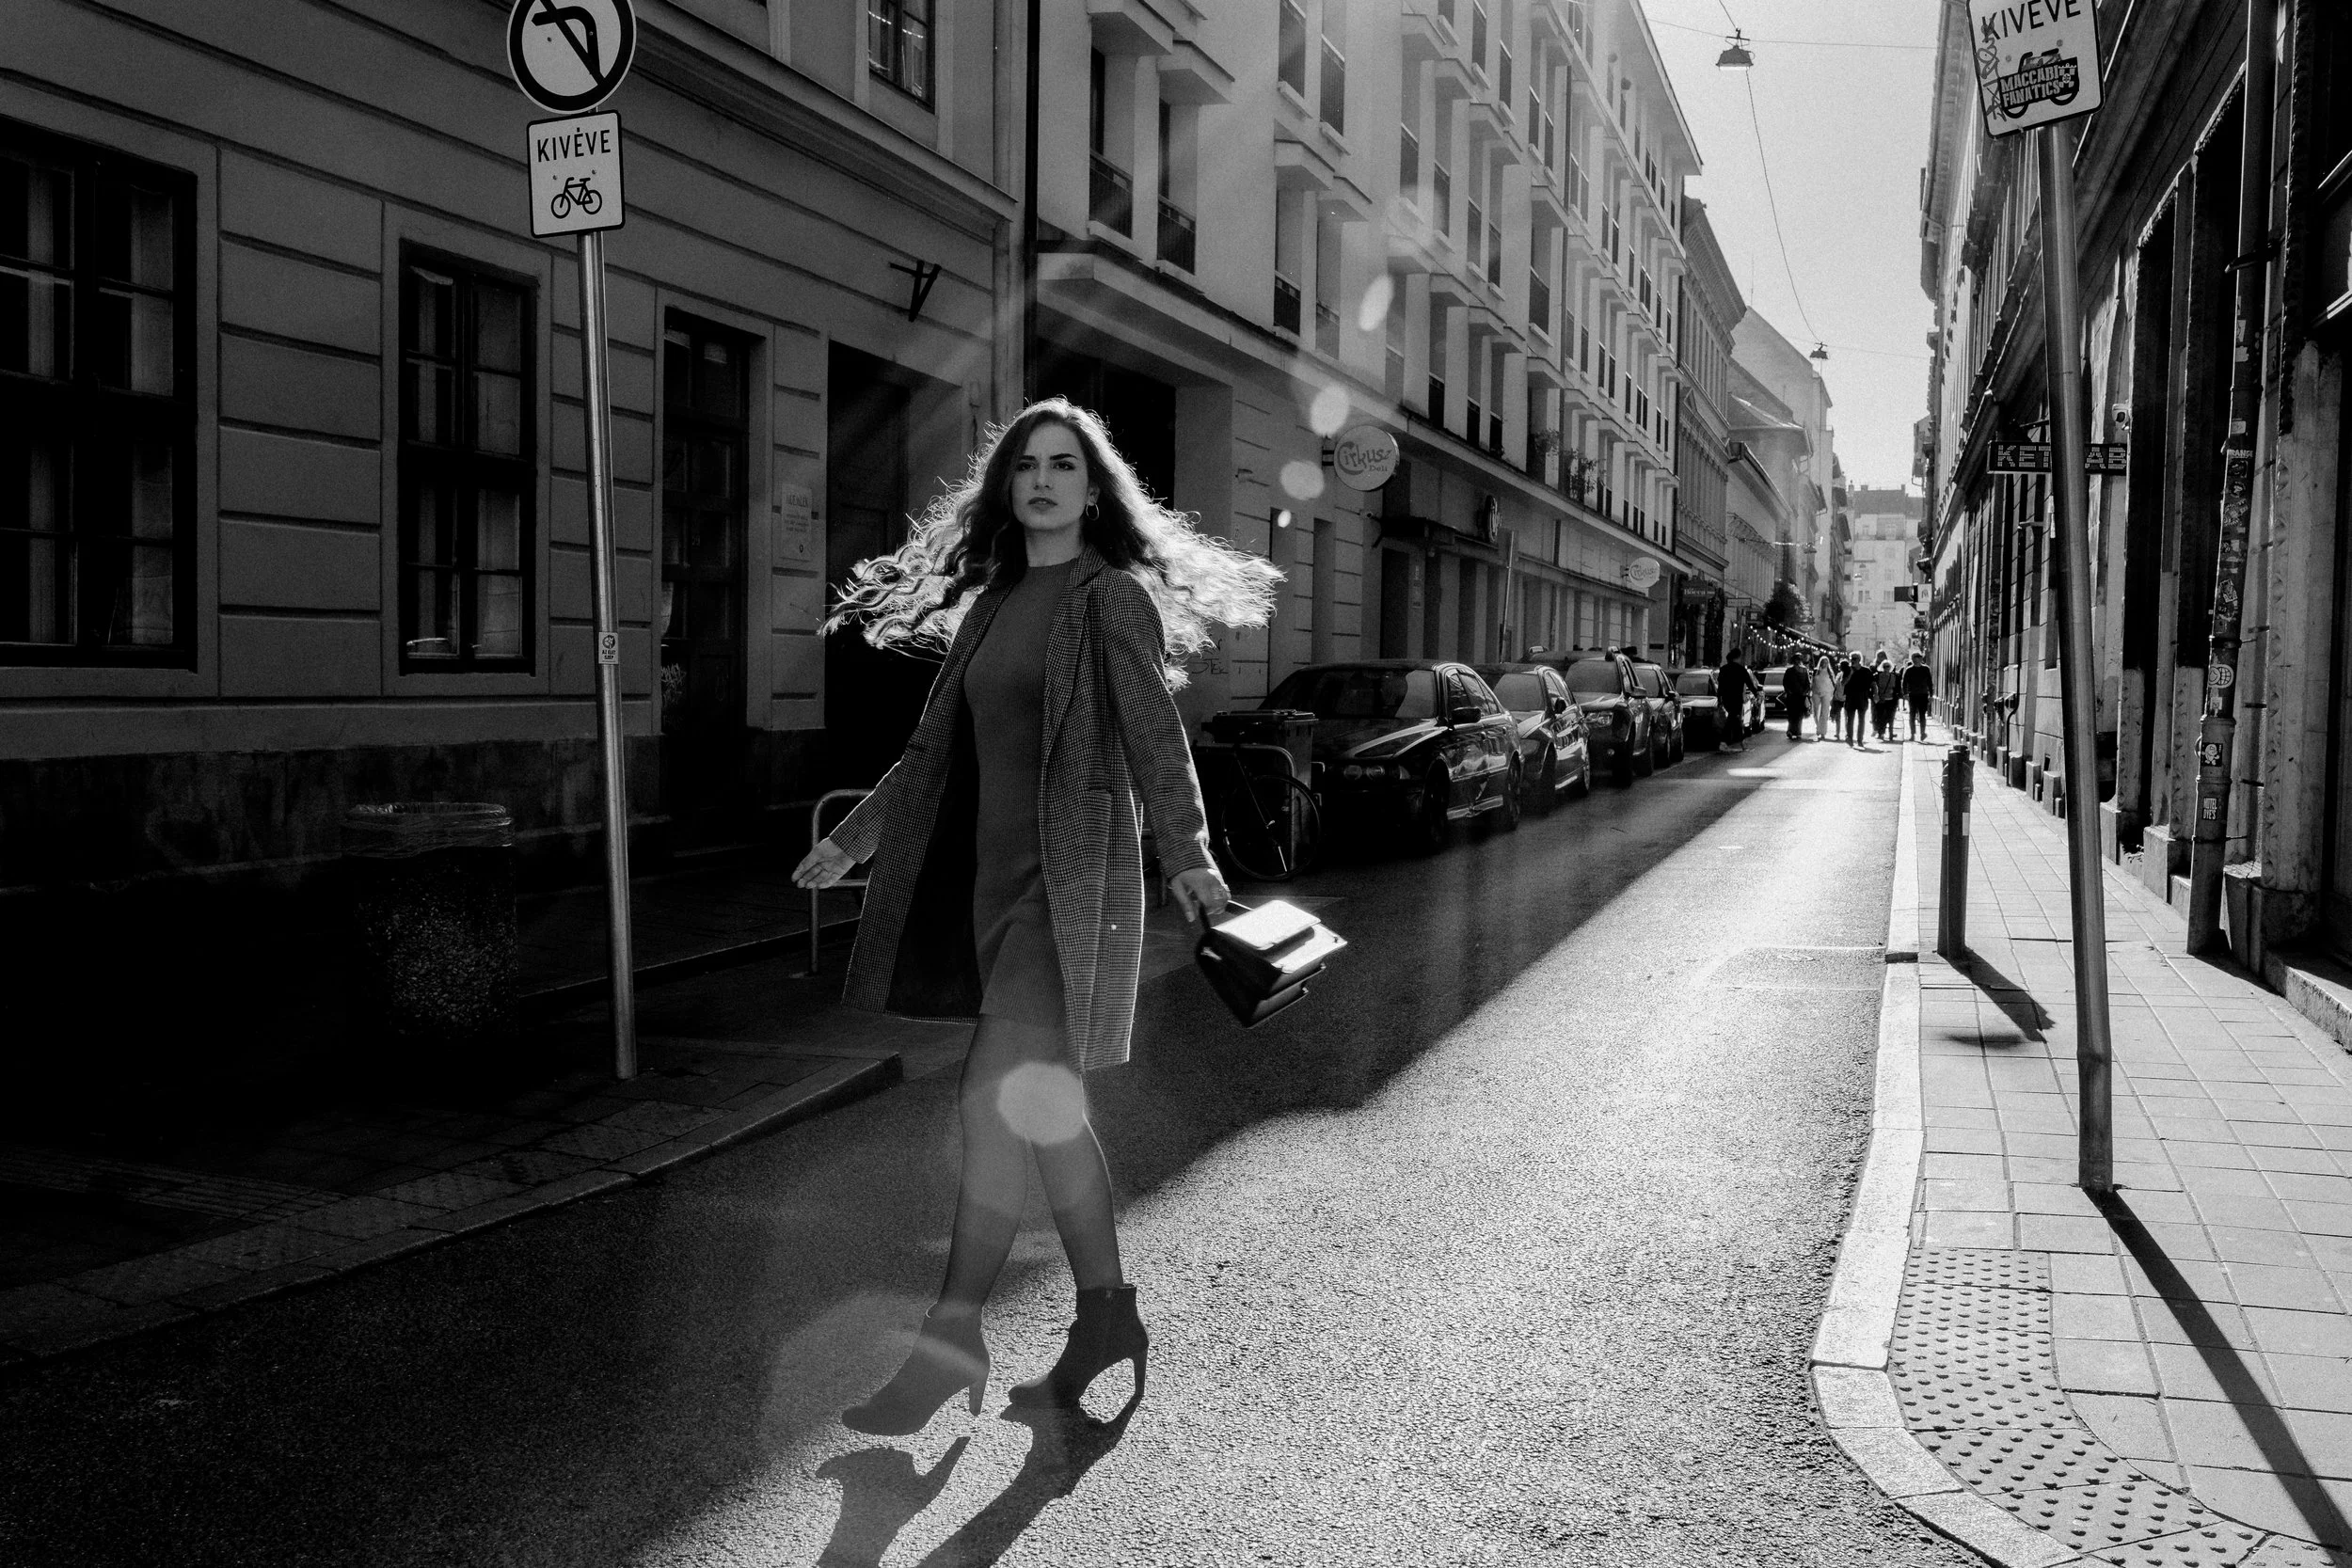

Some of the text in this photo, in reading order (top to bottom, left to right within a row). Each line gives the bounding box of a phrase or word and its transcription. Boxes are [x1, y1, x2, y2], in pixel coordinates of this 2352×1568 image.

[2000, 65, 2059, 92] MACCABI
[2002, 79, 2060, 107] FANATICS
[1337, 440, 1393, 476] Cirkusz
